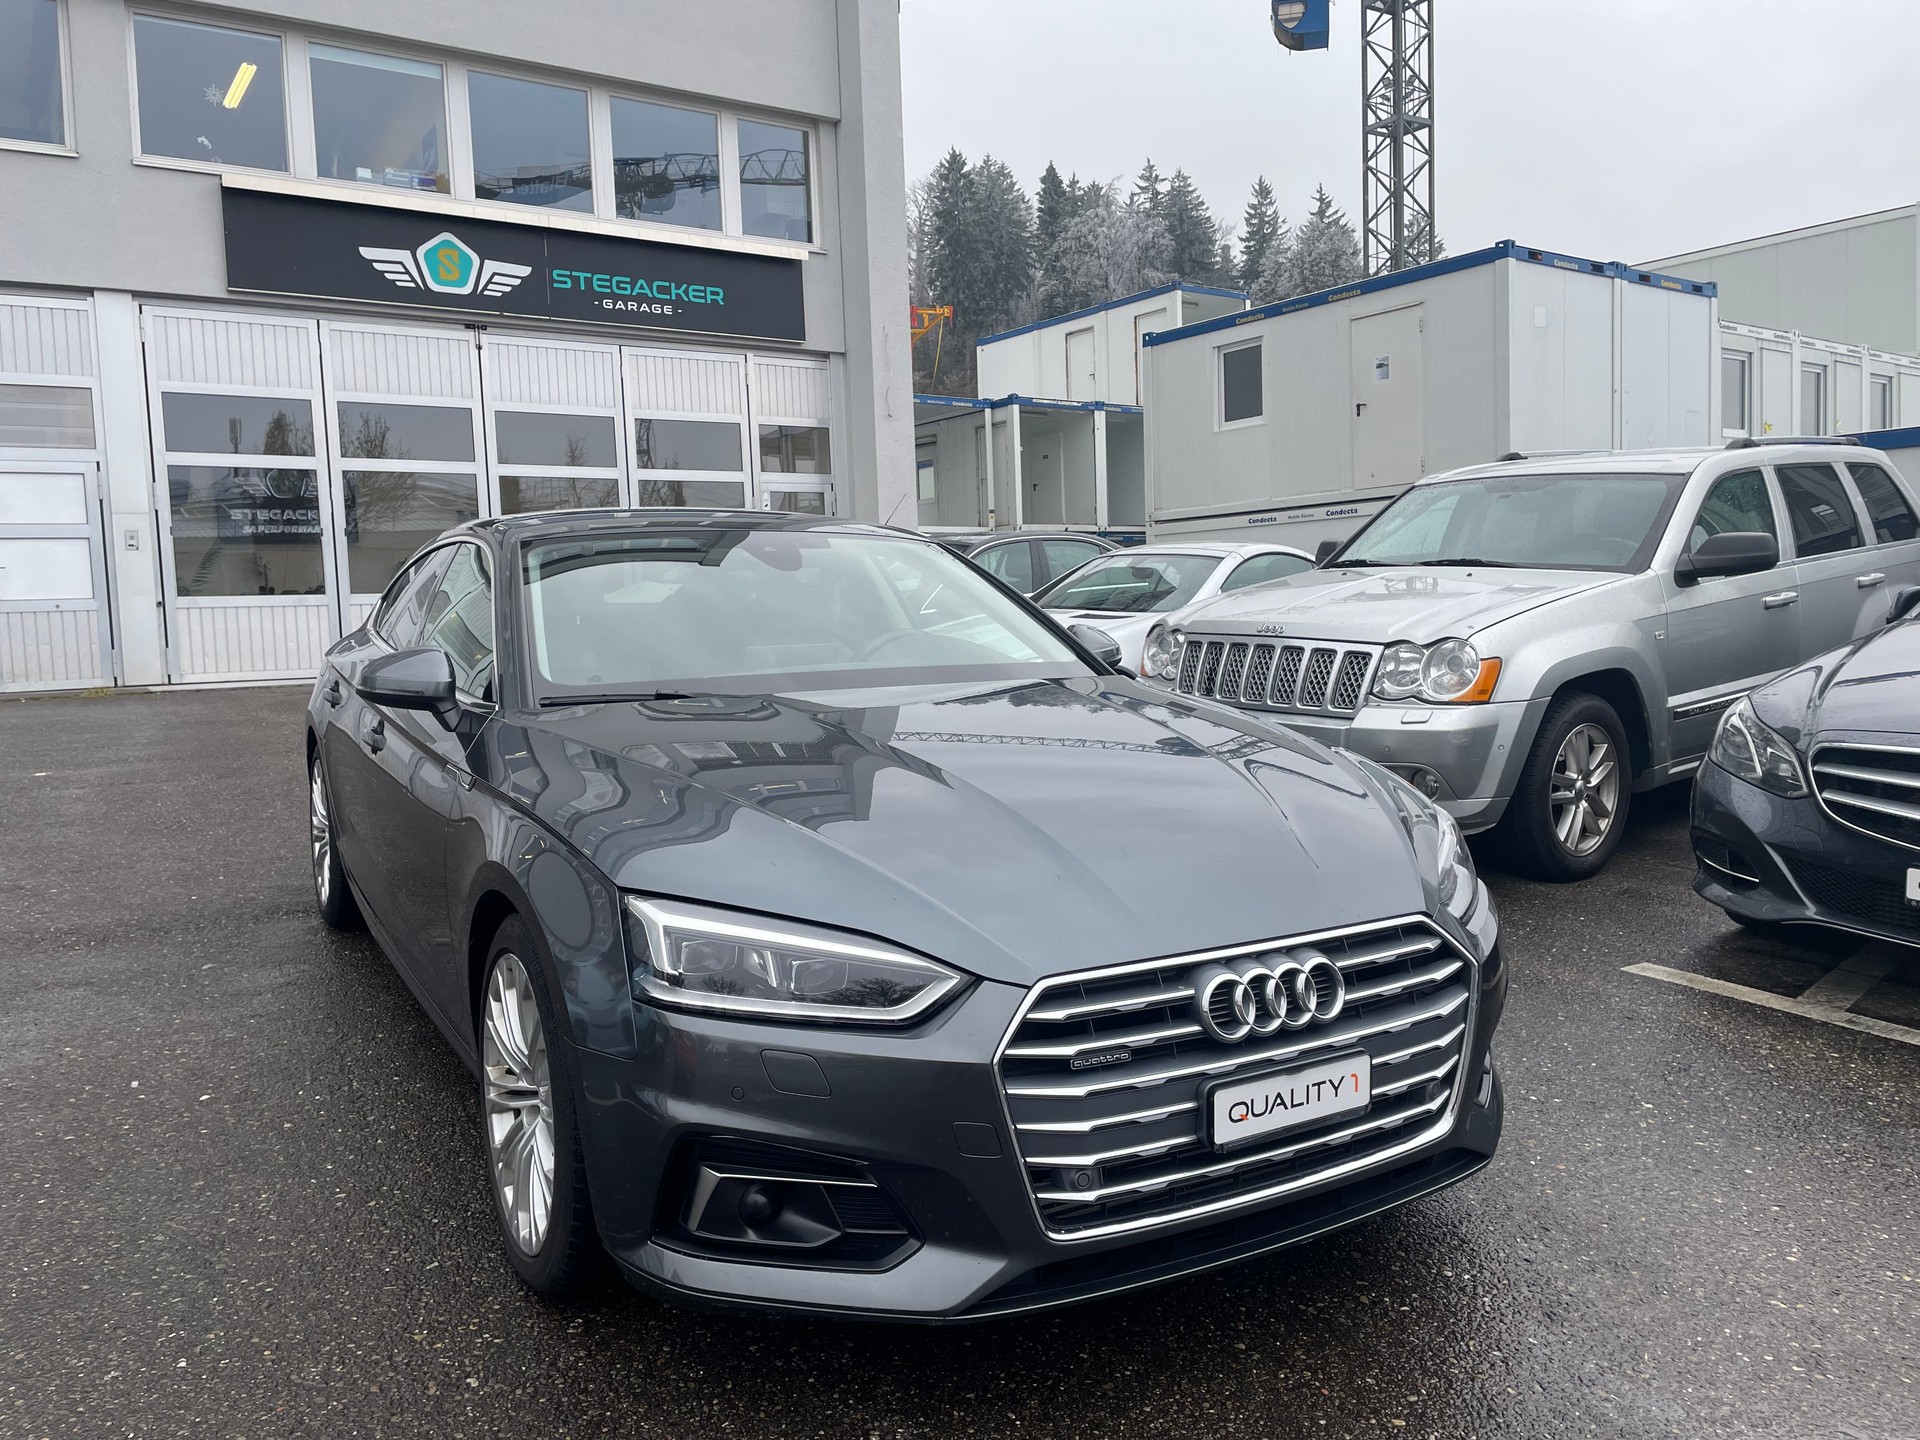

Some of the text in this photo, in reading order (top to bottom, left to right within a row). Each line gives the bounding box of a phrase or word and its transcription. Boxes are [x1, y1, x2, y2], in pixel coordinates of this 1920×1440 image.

[437, 248, 460, 281] S
[552, 269, 725, 305] STEGACKER
[1235, 313, 1265, 325] Condecta
[1328, 289, 1362, 302] Condecta
[1248, 516, 1278, 525] Condecta
[1326, 507, 1359, 517] Condecta
[1256, 622, 1286, 636] Jeep
[1074, 1052, 1129, 1068] quattro
